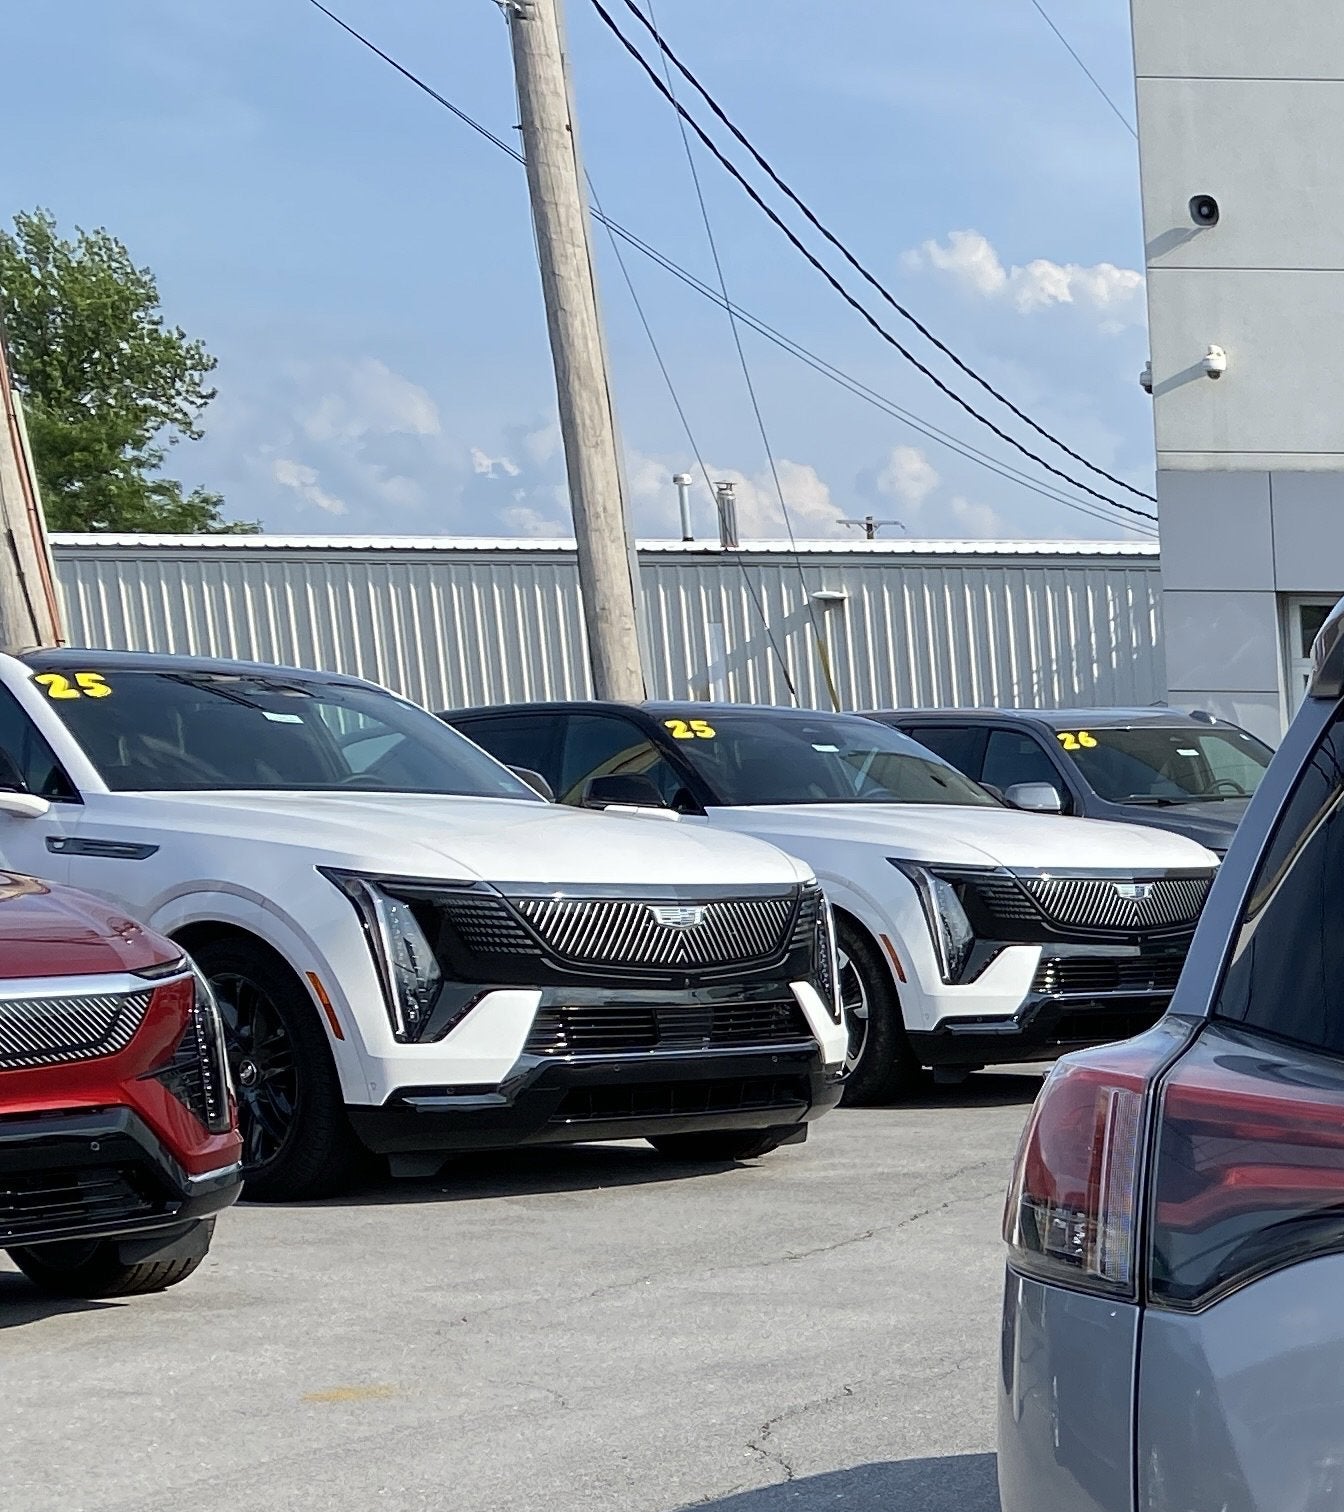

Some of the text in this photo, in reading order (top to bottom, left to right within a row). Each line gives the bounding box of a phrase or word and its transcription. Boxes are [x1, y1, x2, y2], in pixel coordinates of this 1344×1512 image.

[34, 673, 112, 699] 25
[664, 720, 716, 739] 25
[1057, 731, 1097, 750] 26
